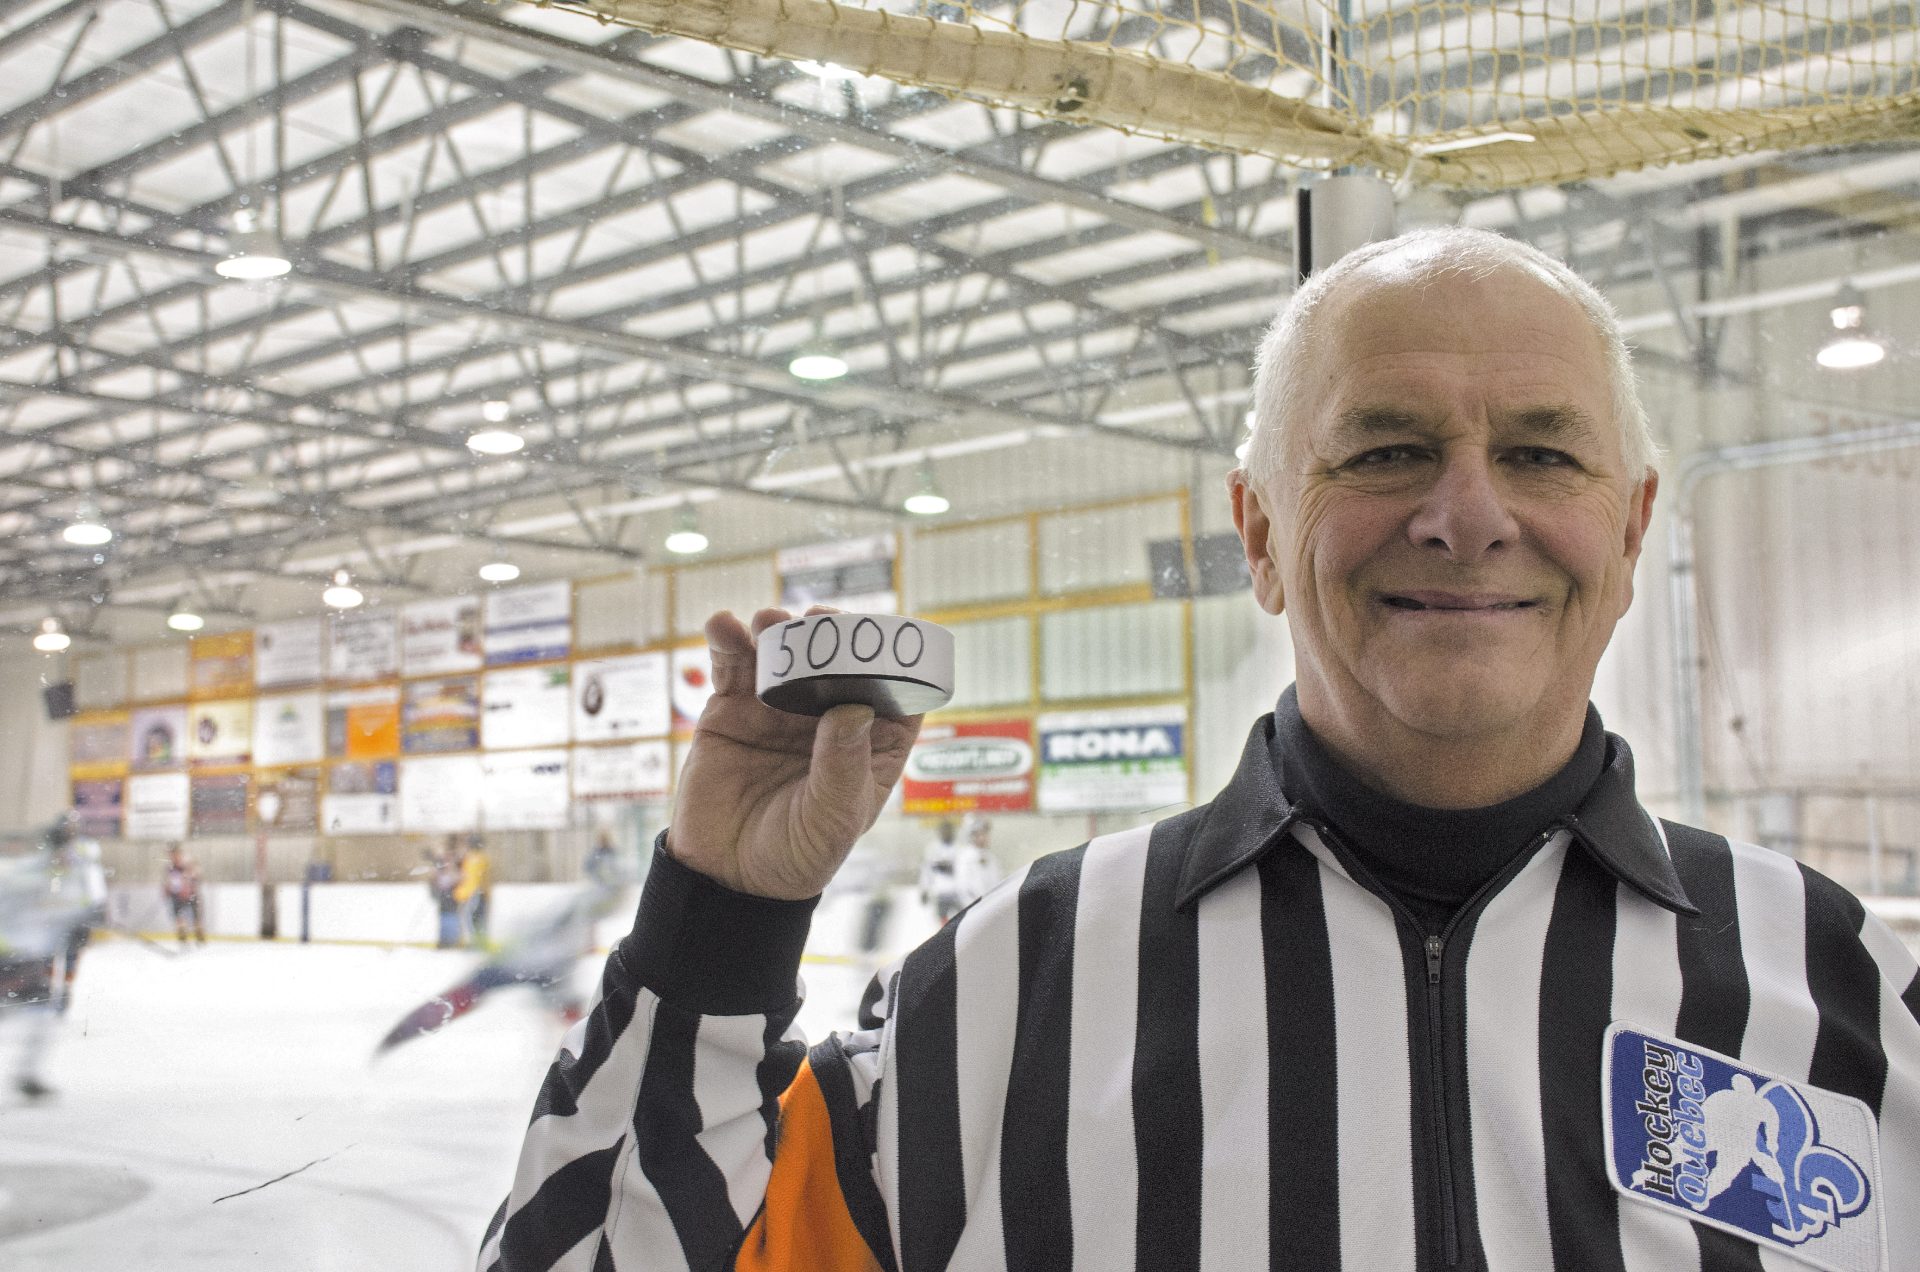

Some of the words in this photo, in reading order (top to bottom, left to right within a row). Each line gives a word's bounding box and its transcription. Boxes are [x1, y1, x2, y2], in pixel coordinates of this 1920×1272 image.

[772, 615, 925, 678] 5000
[1049, 729, 1173, 760] RONA
[1636, 1041, 1678, 1198] Hockey
